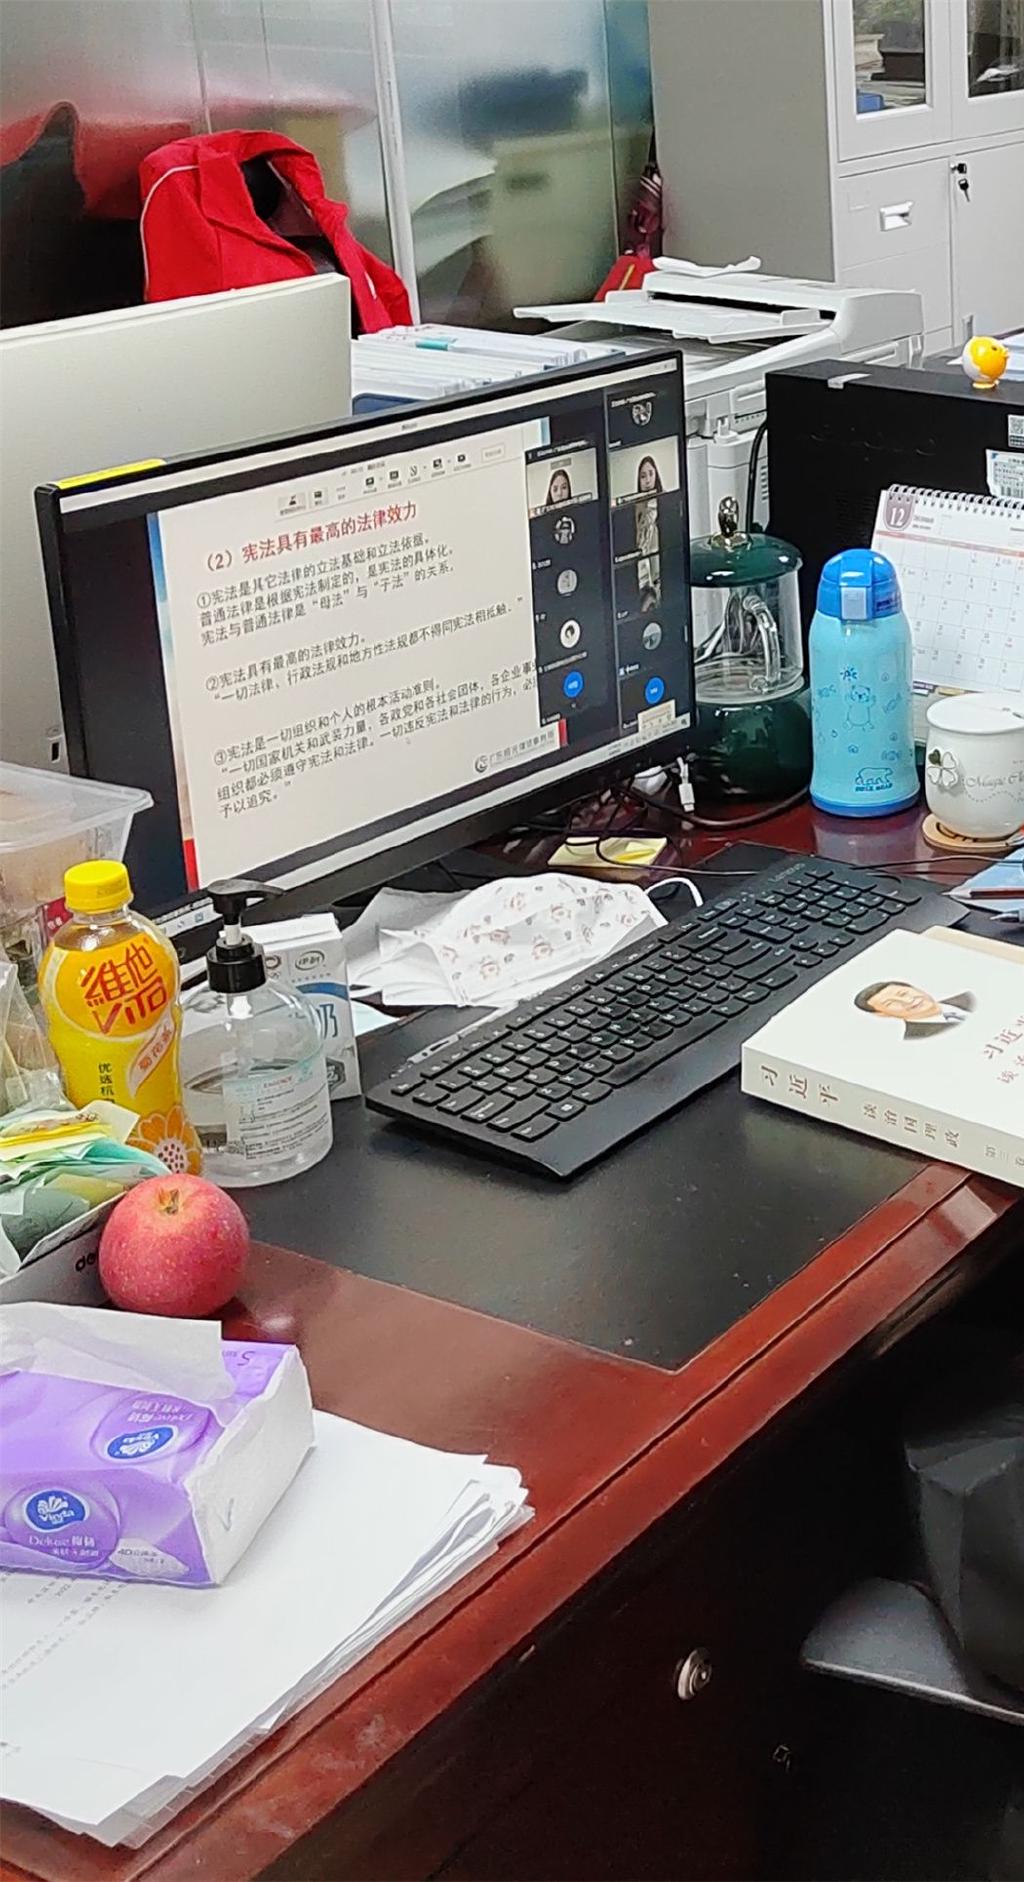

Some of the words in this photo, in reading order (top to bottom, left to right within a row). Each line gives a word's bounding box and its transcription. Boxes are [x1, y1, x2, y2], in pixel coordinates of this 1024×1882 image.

[889, 508, 905, 526] 12
[760, 1064, 839, 1106] 习近平
[862, 1103, 960, 1149] 谈治国理政
